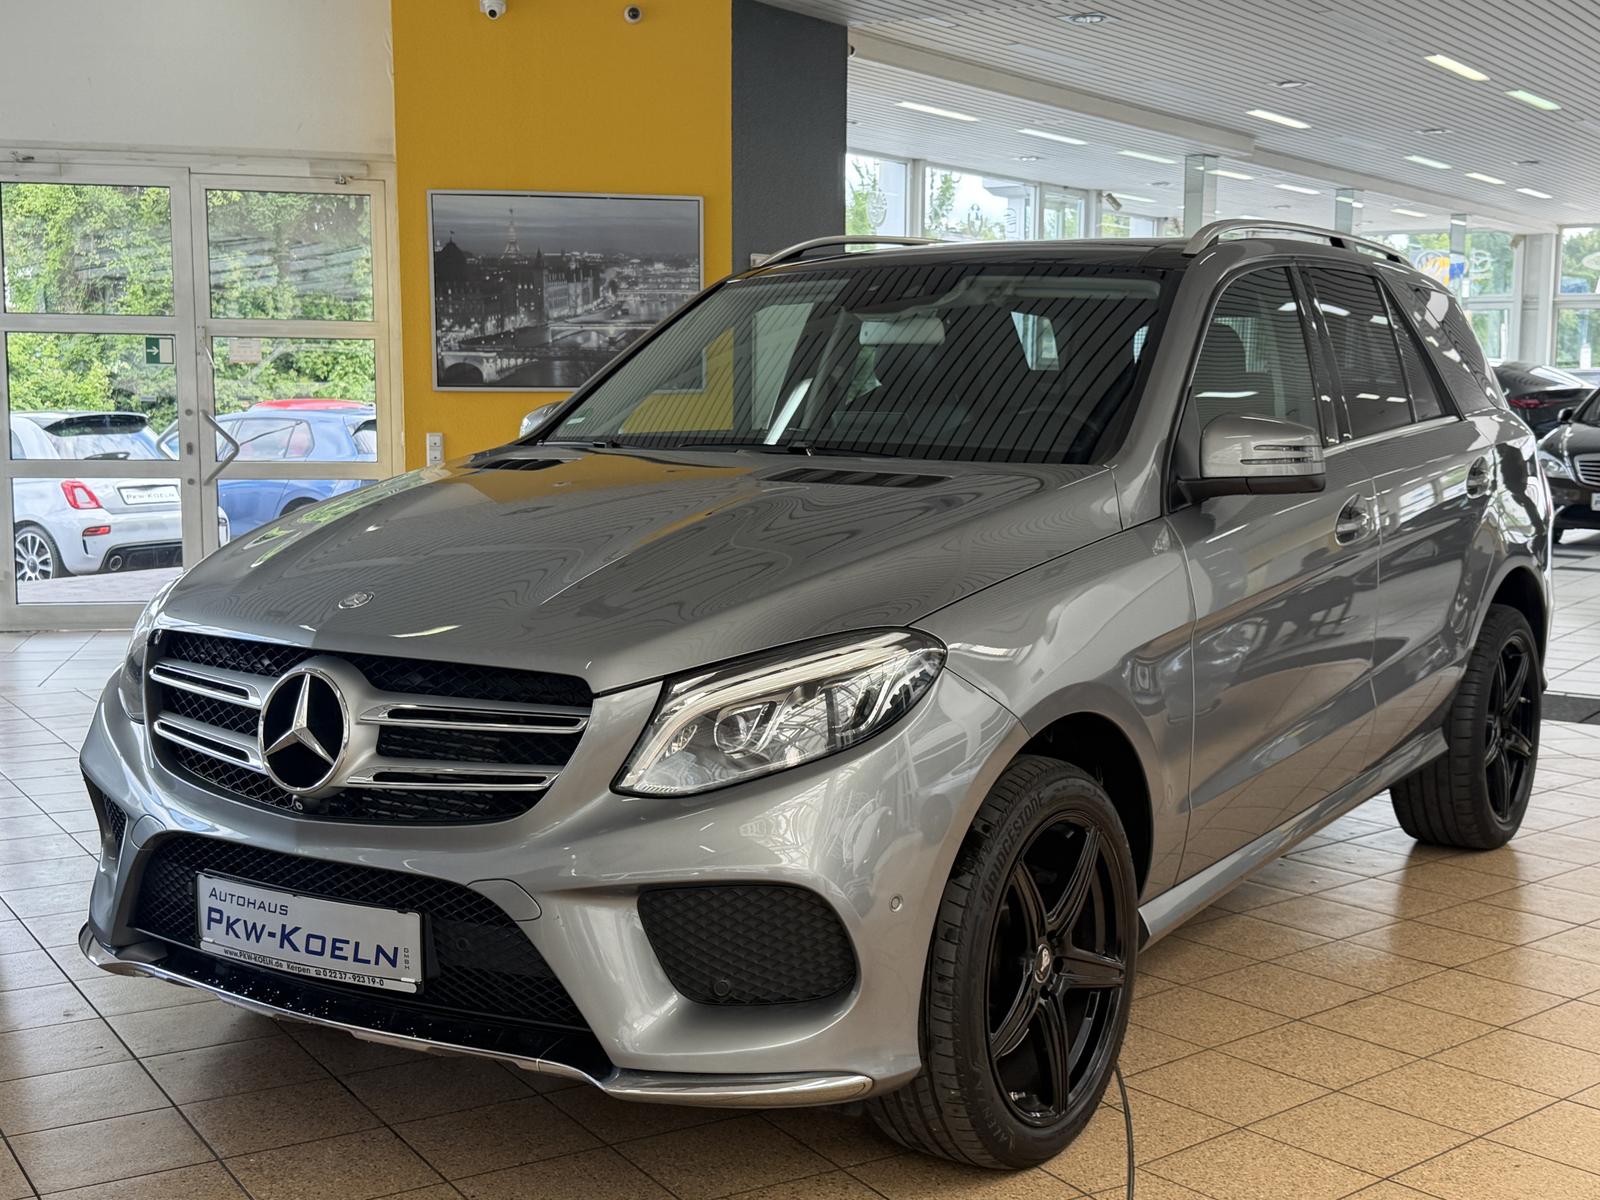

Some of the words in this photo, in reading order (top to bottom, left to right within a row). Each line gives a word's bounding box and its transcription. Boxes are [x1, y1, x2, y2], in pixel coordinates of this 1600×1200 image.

[209, 887, 289, 915] AUTOHAUS
[206, 906, 399, 968] PKW-KOELN
[286, 963, 311, 974] Kerpen
